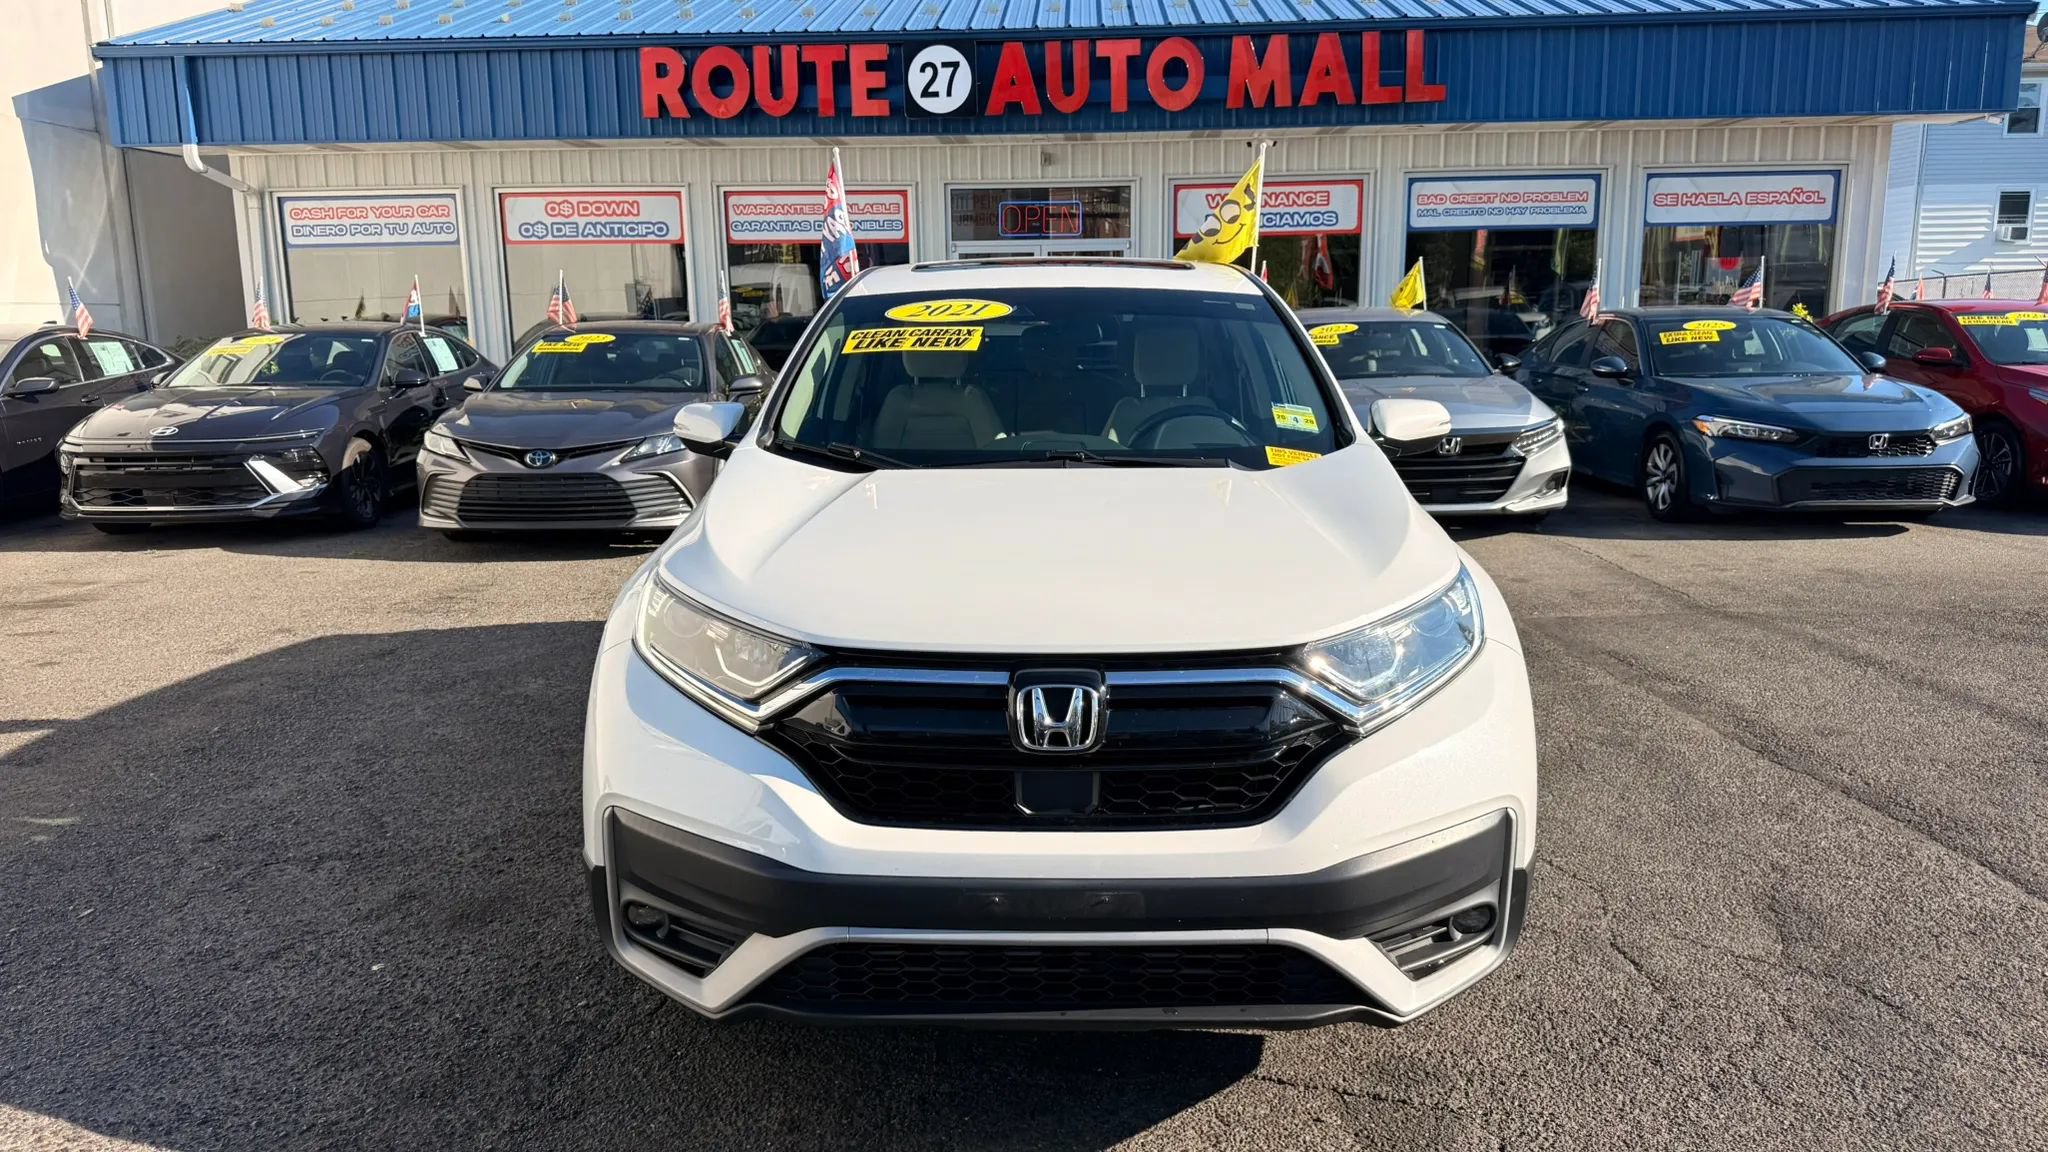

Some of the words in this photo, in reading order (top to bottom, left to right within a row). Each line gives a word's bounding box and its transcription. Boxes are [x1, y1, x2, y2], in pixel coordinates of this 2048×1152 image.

[639, 42, 892, 120] ROUTE
[918, 60, 962, 99] 27
[984, 35, 1206, 116] AUTO
[1226, 28, 1447, 109] MALL
[1417, 194, 1447, 205] BAD
[1449, 193, 1498, 205] CREDIT
[1499, 192, 1521, 203] NO
[1523, 191, 1589, 202] PROBLEM
[1653, 193, 1679, 207] SE
[1680, 191, 1743, 207] HABLA
[1745, 187, 1826, 206] ESPAÑOL
[290, 207, 335, 220] CASH
[336, 206, 368, 219] FOR
[370, 205, 414, 218] YOUR
[416, 205, 450, 218] CAR
[577, 201, 640, 217] DOWN
[732, 203, 824, 216] WARRANTIES
[1417, 208, 1441, 217] MAL
[1442, 207, 1486, 216] CREDITO
[1487, 207, 1504, 216] NO
[1505, 207, 1528, 215] HAY
[1529, 206, 1587, 215] PROBLEMA
[731, 220, 813, 232] GARANTIAS
[1002, 205, 1080, 233] OPEN
[291, 224, 348, 237] DINERO
[349, 223, 383, 236] POR
[384, 222, 409, 235] TU
[411, 221, 456, 235] AUTO
[551, 222, 579, 238] DE
[581, 221, 670, 237] ANTICIPO
[906, 303, 988, 318] 2021
[851, 330, 907, 341] CLEAN
[908, 328, 977, 338] CARFAX
[853, 338, 908, 350] LIKE
[911, 336, 971, 348] NEW
